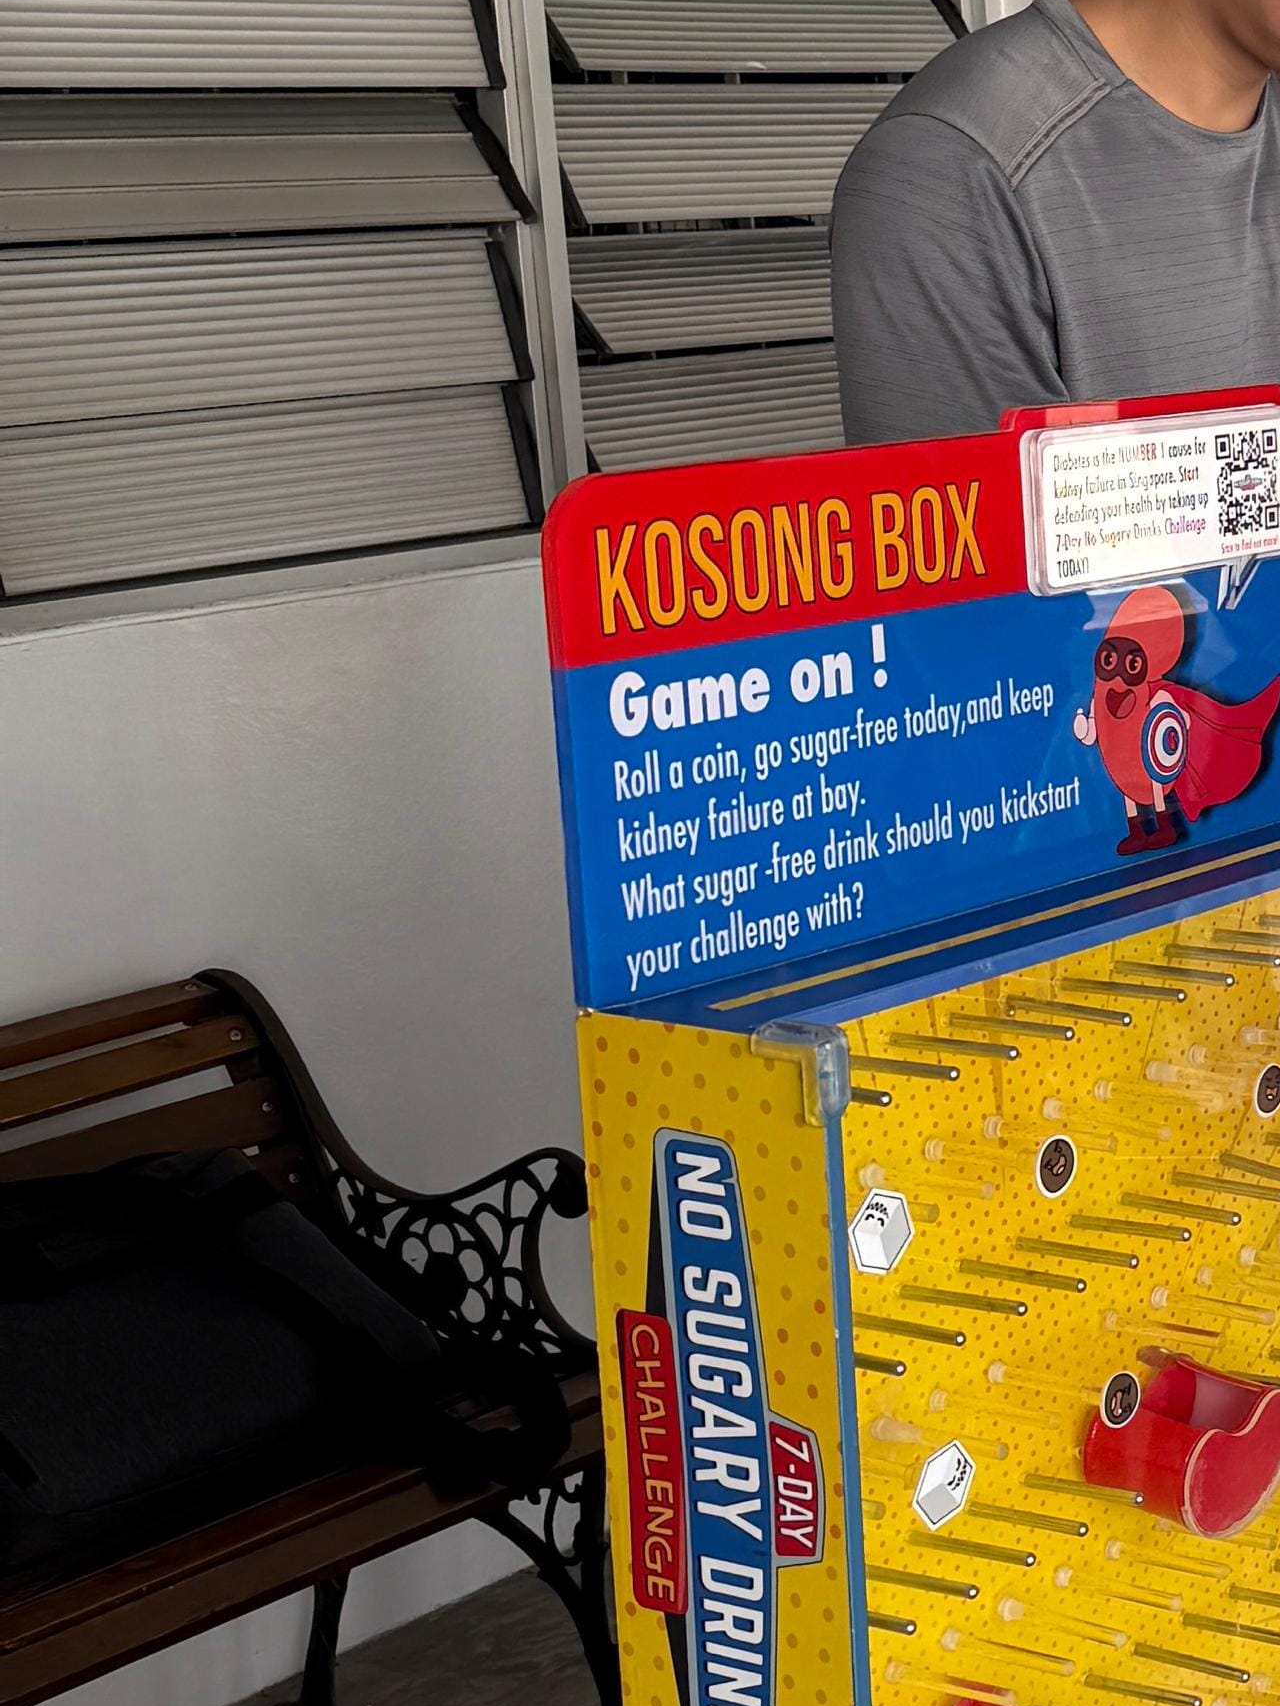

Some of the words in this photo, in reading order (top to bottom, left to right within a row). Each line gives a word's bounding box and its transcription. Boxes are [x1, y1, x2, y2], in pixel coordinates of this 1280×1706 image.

[1102, 447, 1116, 466] the
[1118, 442, 1157, 464] NUMBER
[1194, 436, 1206, 455] for
[1178, 465, 1199, 483] Start
[1101, 504, 1121, 522] your
[1124, 494, 1152, 515] health
[1155, 493, 1166, 514] by
[1169, 489, 1196, 510] taking
[1198, 492, 1208, 509] up
[1165, 514, 1206, 535] Challenge
[594, 497, 855, 636] KOSONG
[870, 480, 987, 592] BOX
[609, 666, 771, 738] Game
[790, 650, 854, 703] on
[613, 749, 661, 802] Roll
[669, 760, 684, 790] a
[691, 742, 747, 784] coin,
[754, 740, 783, 781] go
[790, 707, 898, 768] sugar-free
[1008, 677, 1054, 718] keep
[617, 811, 701, 863] kidney
[707, 791, 785, 841] failure
[791, 785, 814, 821] at
[819, 772, 867, 818] bay.
[620, 872, 686, 922] What
[693, 861, 759, 907] sugar
[764, 840, 817, 884] -free
[823, 818, 880, 870] drink
[885, 799, 953, 855] should
[958, 803, 996, 845] you
[1000, 776, 1081, 825] kickstart
[626, 940, 683, 993] your
[689, 908, 801, 951] challenge
[805, 881, 865, 932] with?
[674, 1151, 732, 1241] NO
[684, 1267, 763, 1543] SUGARY
[630, 1323, 676, 1605] CHALLENGE
[774, 1432, 818, 1557] 7-DAY
